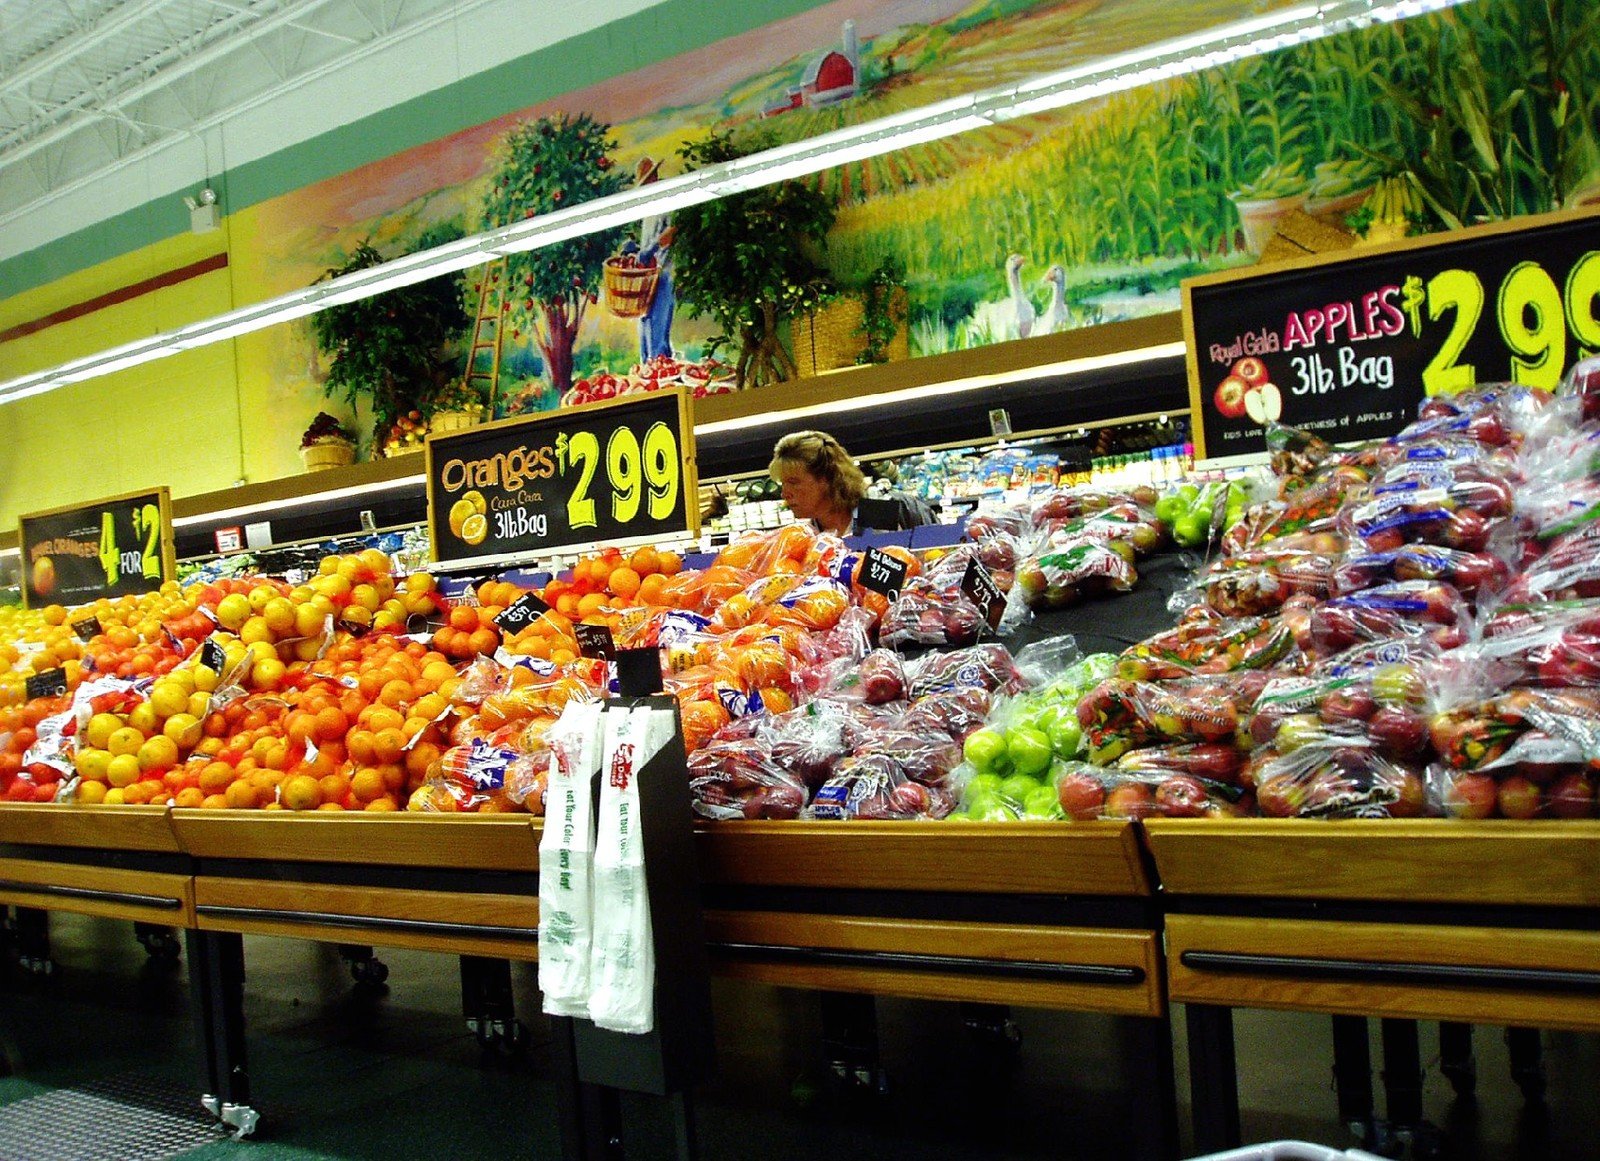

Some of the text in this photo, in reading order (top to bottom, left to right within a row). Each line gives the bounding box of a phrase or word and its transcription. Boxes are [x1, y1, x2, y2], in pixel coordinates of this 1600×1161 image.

[1242, 328, 1280, 357] Gala
[1283, 285, 1405, 351] APPLES
[1338, 346, 1395, 390] Bag
[1356, 411, 1393, 424] APPLES
[441, 445, 556, 492] Oranges
[490, 489, 543, 512] Cara Cara
[100, 512, 120, 586] 4
[120, 551, 142, 574] FOR
[564, 803, 577, 826] Your
[620, 803, 629, 817] Eat
